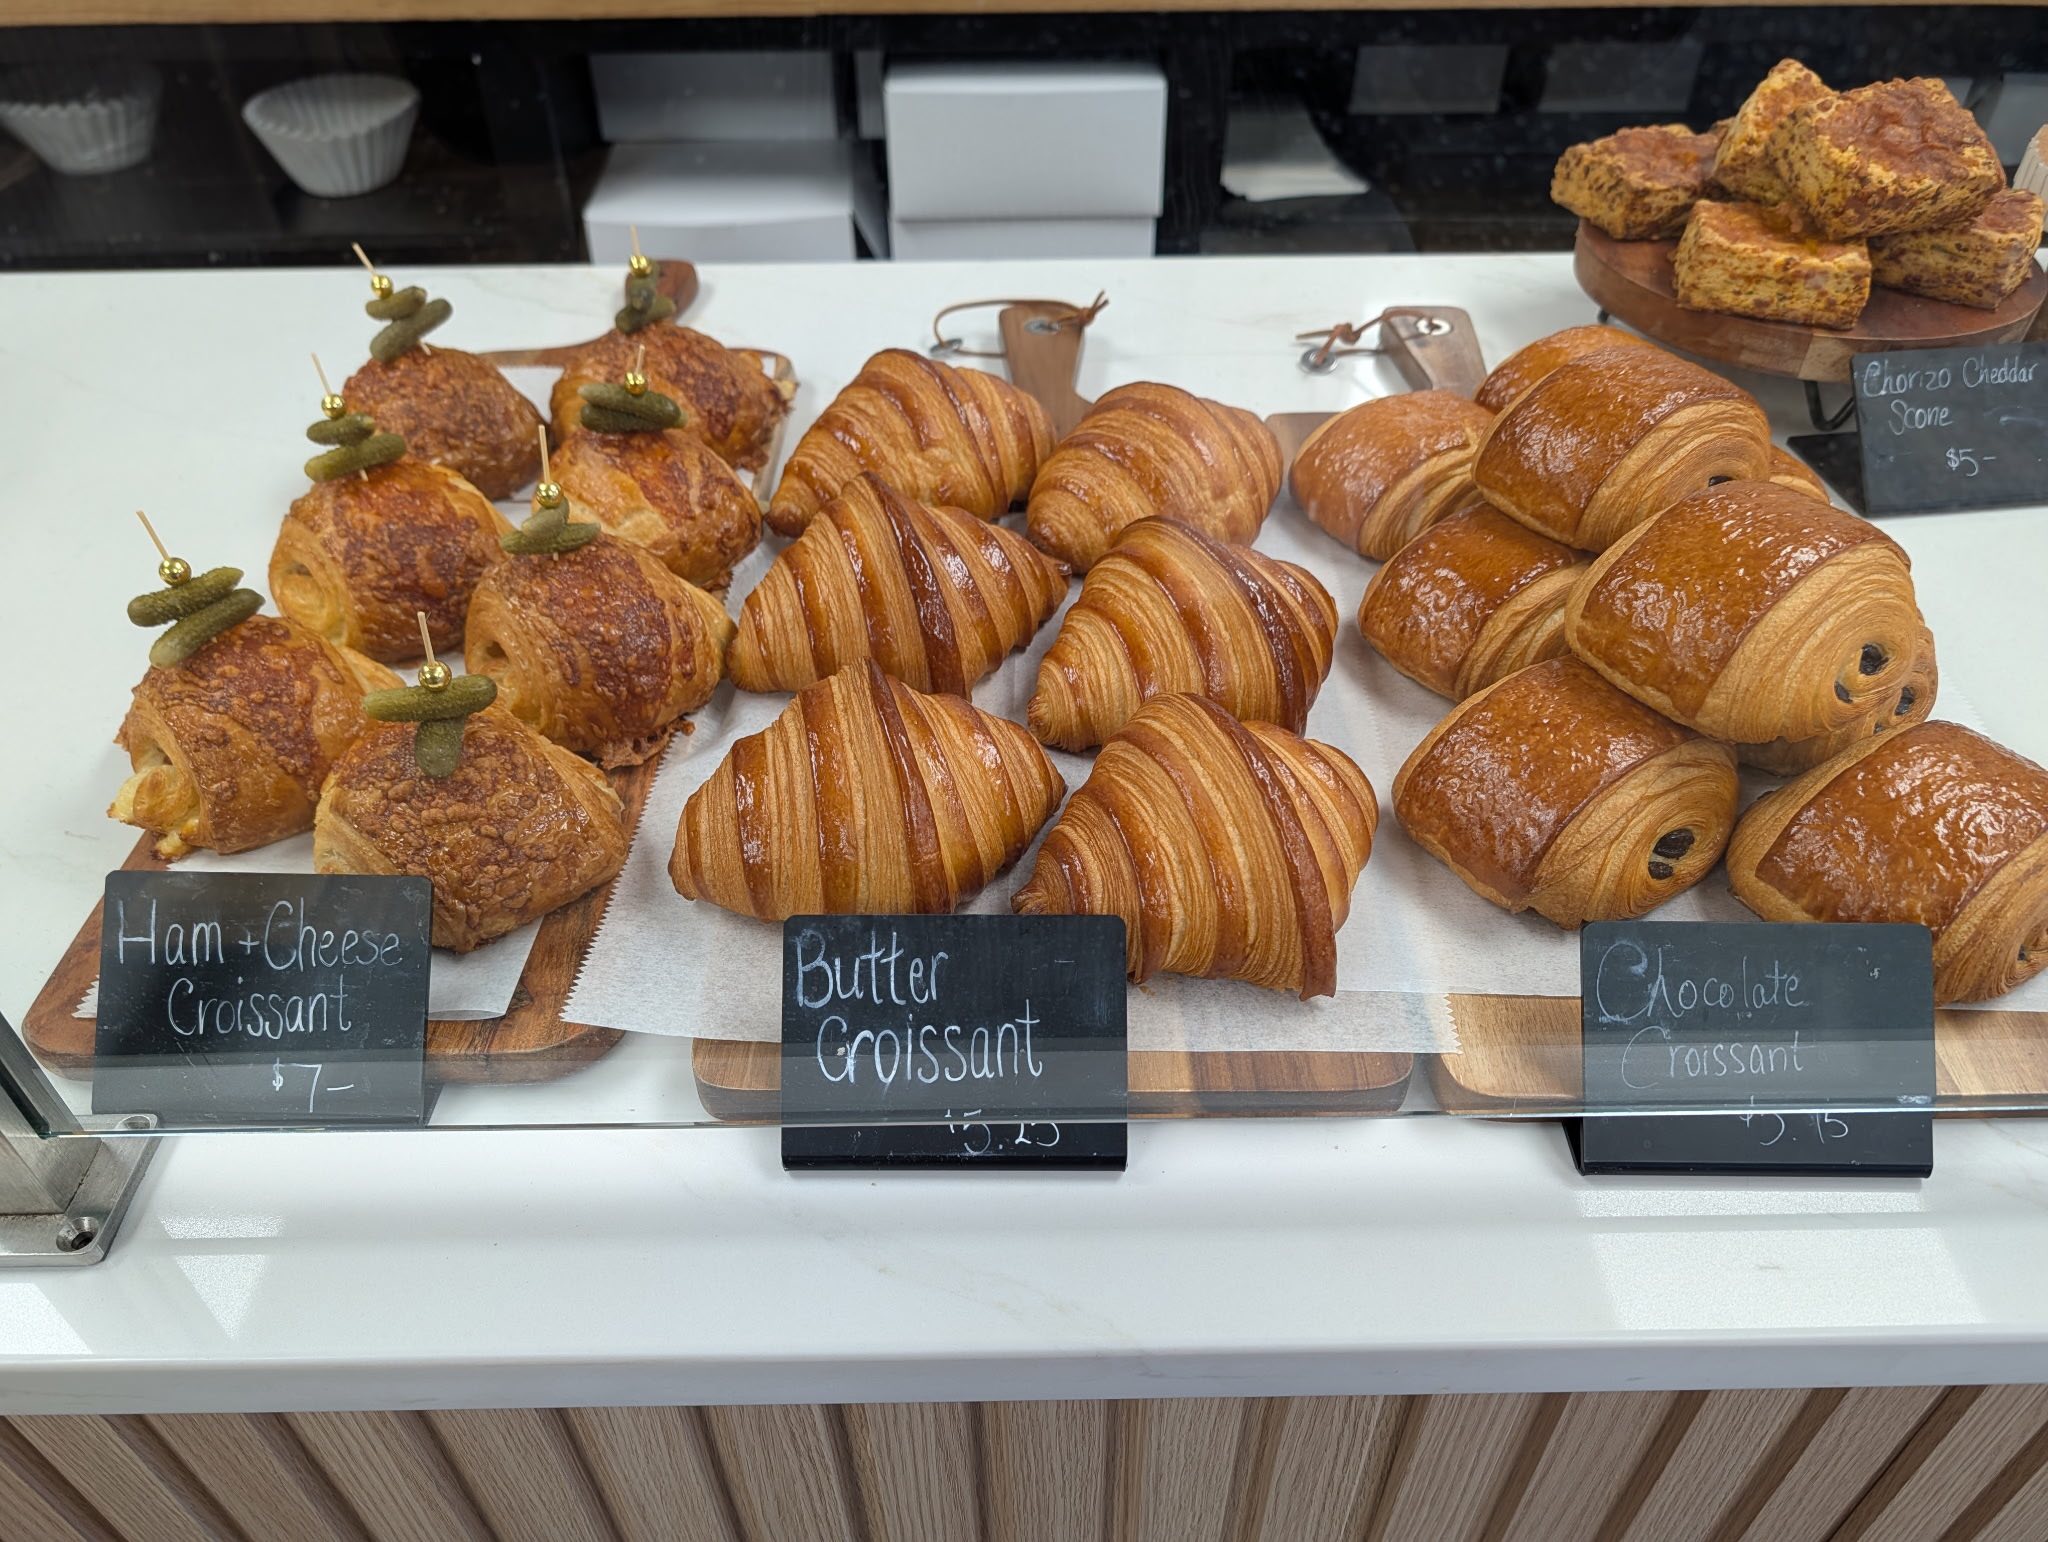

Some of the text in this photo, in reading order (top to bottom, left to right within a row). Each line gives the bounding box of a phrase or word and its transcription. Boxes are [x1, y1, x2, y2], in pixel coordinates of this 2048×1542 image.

[1863, 353, 2039, 398] Chorizo Cheddar
[1888, 398, 1953, 436] Scone
[118, 898, 224, 967] Ham
[264, 896, 403, 972] Cheese
[795, 928, 949, 1009] Butter
[168, 973, 352, 1040] Croissant
[1596, 940, 1806, 1022] Chocolate
[816, 998, 1043, 1085] Croissant
[1621, 1025, 1815, 1090] Croissant
